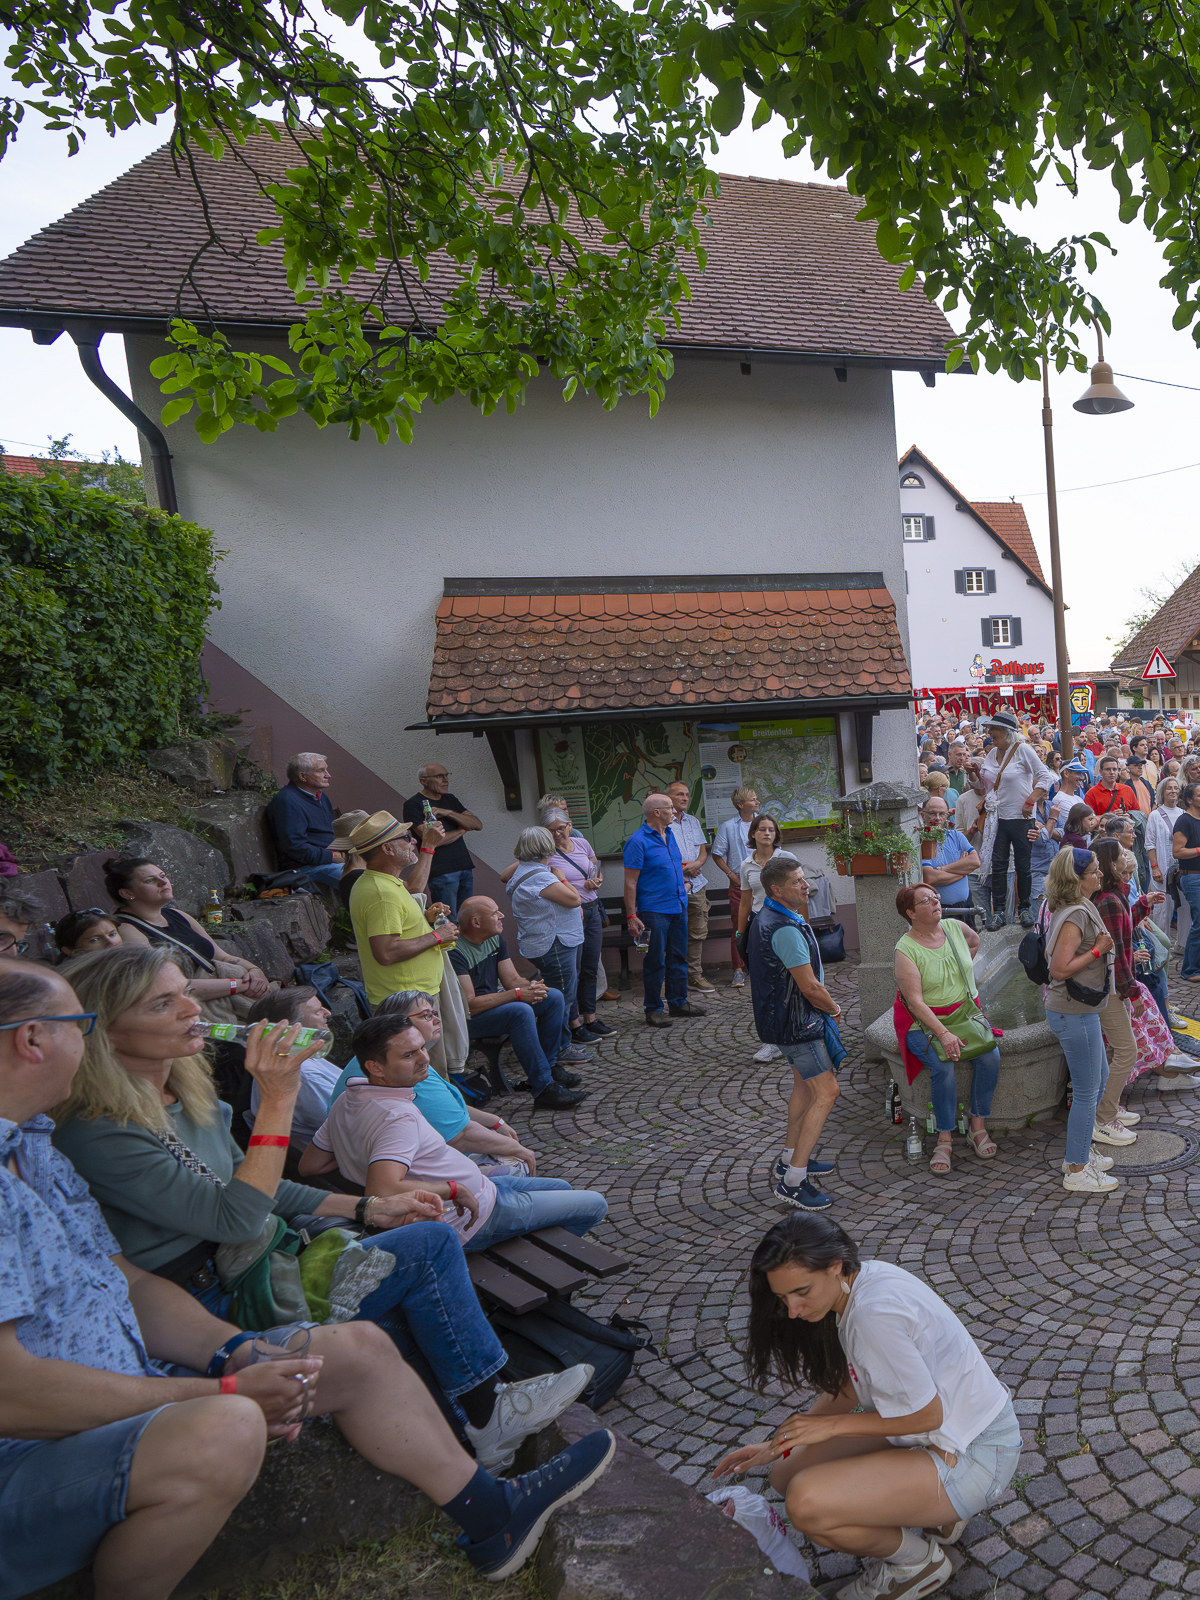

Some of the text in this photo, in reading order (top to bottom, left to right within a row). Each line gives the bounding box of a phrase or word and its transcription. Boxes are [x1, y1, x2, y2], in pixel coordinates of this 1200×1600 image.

[990, 658, 1045, 678] Rothaus
[752, 727, 794, 738] Breitenfeld
[1098, 1128, 1111, 1138] HOKA
[504, 1410, 518, 1427] FILA
